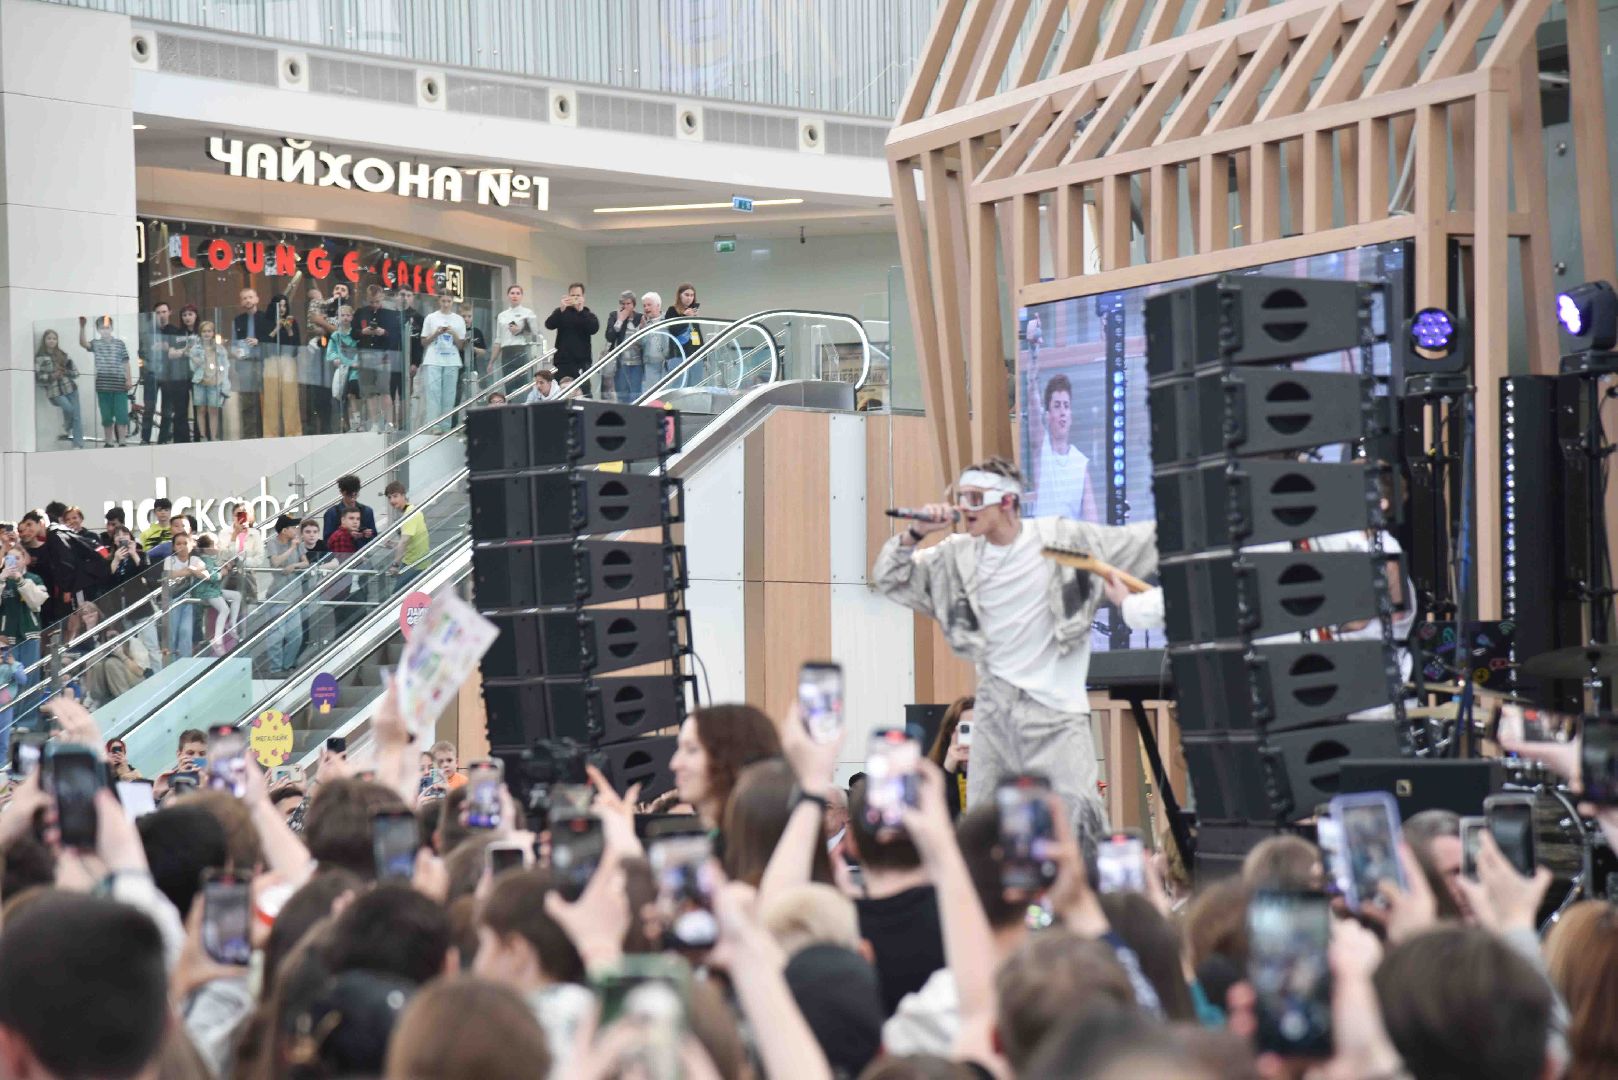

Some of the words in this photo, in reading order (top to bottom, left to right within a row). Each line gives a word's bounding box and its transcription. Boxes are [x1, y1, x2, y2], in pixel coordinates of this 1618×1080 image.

[210, 137, 462, 202] ЧАЙХОНА
[180, 235, 360, 283] LOUNGE
[382, 258, 437, 296] CAFE
